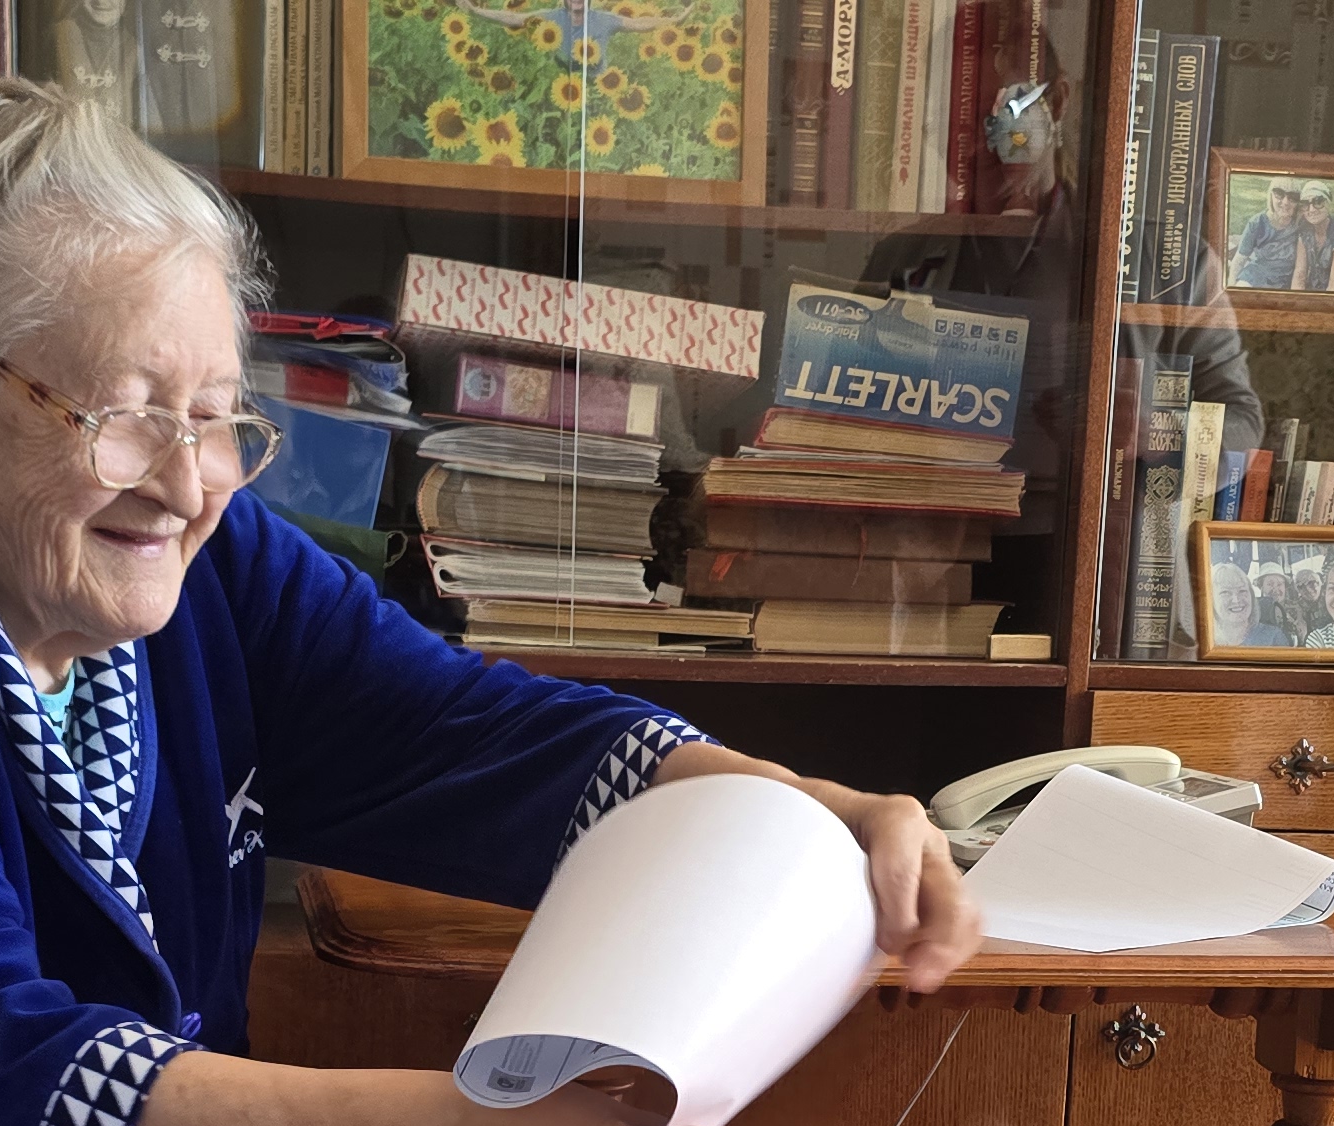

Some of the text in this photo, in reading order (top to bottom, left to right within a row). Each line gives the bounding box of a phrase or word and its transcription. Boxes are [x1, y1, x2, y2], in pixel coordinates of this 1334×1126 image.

[1166, 54, 1197, 205] ИНОСТРАННЫХ СЛОВ
[1160, 209, 1176, 280] СОВРЕМЕННЫЙ
[1170, 223, 1184, 268] СЛОВАРЬ
[835, 326, 861, 341] Hair
[784, 361, 1011, 427] SCARLETT
